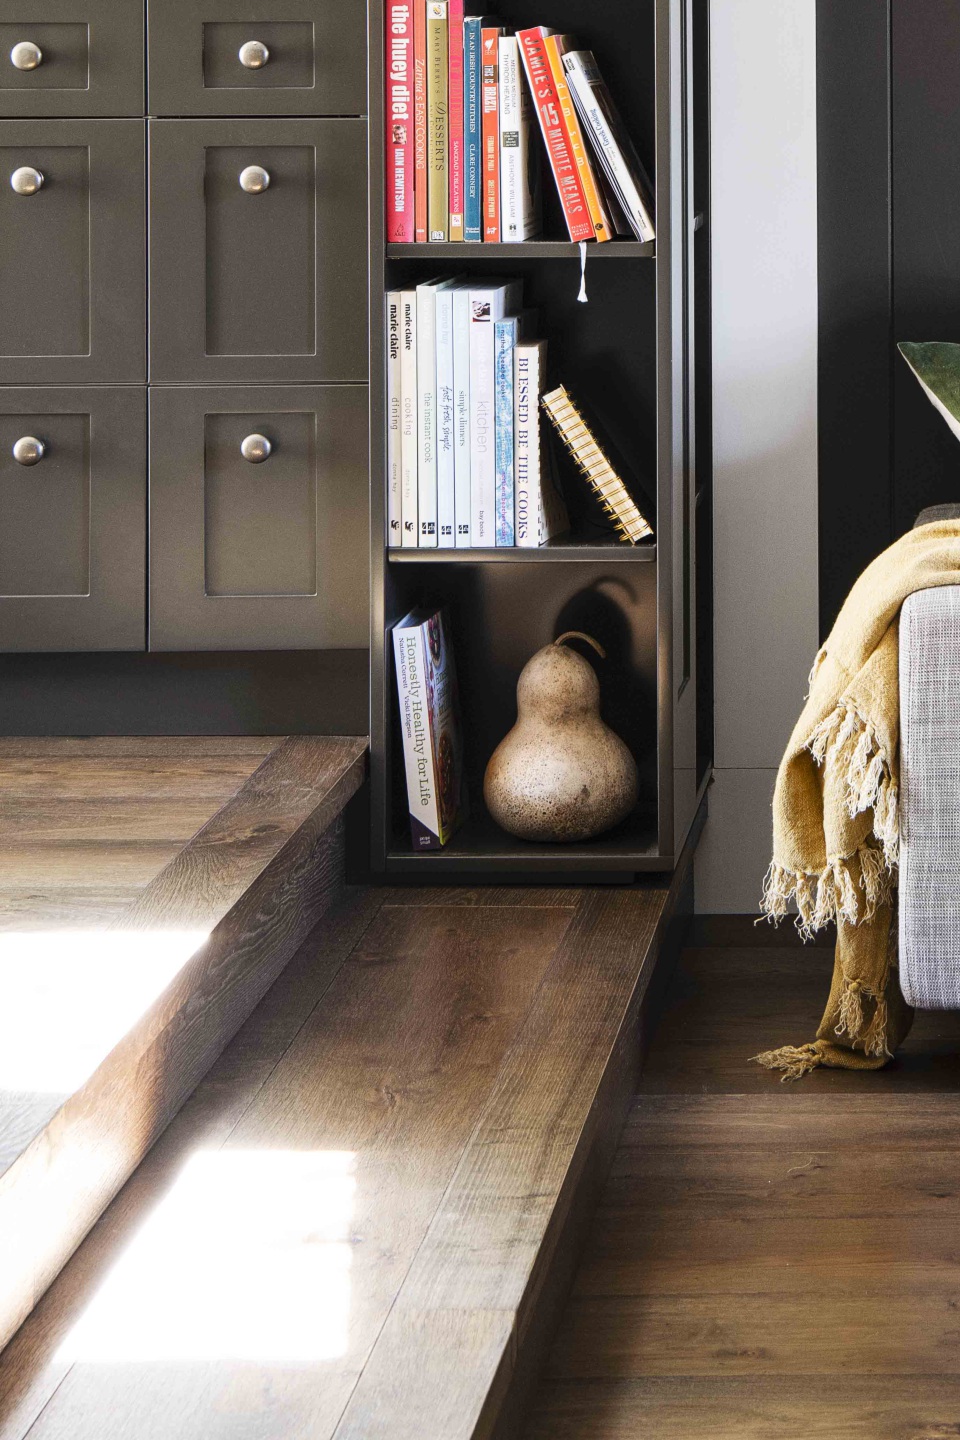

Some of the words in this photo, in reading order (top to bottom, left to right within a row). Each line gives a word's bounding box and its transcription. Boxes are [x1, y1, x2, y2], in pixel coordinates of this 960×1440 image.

[391, 4, 410, 34] the
[469, 32, 476, 40] IN
[469, 40, 476, 51] AN
[390, 38, 410, 82] huey
[484, 65, 494, 77] THIS
[524, 37, 553, 99] JAMIE'S
[415, 58, 425, 101] Zarina's
[391, 85, 411, 121] diet
[484, 86, 497, 113] BRAZIL
[503, 85, 511, 115] HEALING
[540, 102, 560, 127] 15
[415, 103, 425, 127] EASY
[556, 82, 571, 118] dim
[569, 130, 585, 166] sum
[415, 128, 425, 170] COOKING
[435, 101, 447, 172] DESSERTS
[547, 127, 573, 173] MINUTE
[394, 148, 405, 165] IAIN
[394, 167, 405, 213] HEWITSON
[508, 189, 516, 218] WILLIAM
[560, 175, 583, 214] MEALS
[390, 304, 398, 332] marie
[390, 333, 399, 360] claire
[424, 392, 432, 407] the
[457, 390, 468, 416] simple
[518, 357, 529, 423] BLESSED
[390, 397, 399, 430] dining
[404, 397, 413, 436] cooking
[424, 408, 433, 441] instant
[476, 400, 490, 453] kitchen
[459, 417, 468, 447] dinners
[518, 430, 529, 449] BE
[424, 443, 433, 463] cook
[518, 454, 529, 484] THE
[518, 490, 529, 539] COOKS
[406, 636, 421, 698] Honestly
[412, 700, 426, 754] Healthy
[417, 757, 428, 777] for
[419, 778, 431, 806] Life
